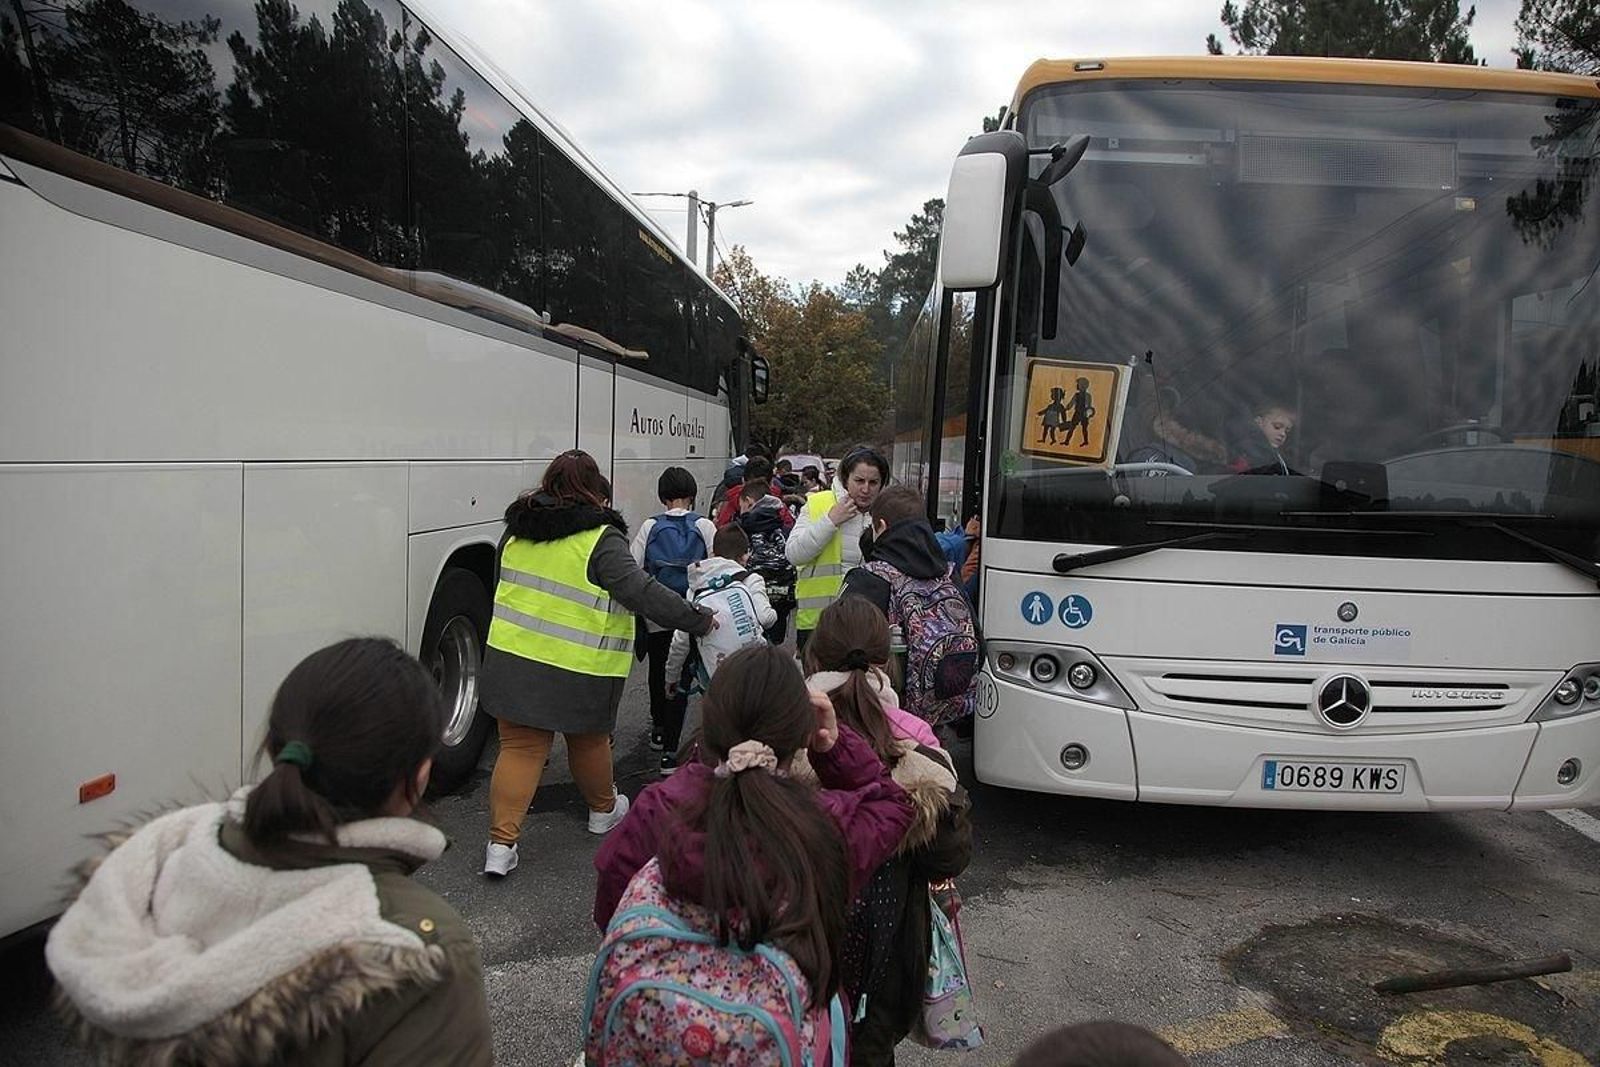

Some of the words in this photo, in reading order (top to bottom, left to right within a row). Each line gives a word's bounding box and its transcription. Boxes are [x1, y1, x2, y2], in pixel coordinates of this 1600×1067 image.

[1313, 626, 1369, 635] transporte
[1371, 627, 1411, 637] público
[1313, 636, 1326, 644] de
[1329, 636, 1366, 645] Galicia
[1280, 765, 1344, 789] 0689
[1352, 767, 1398, 790] KWS
